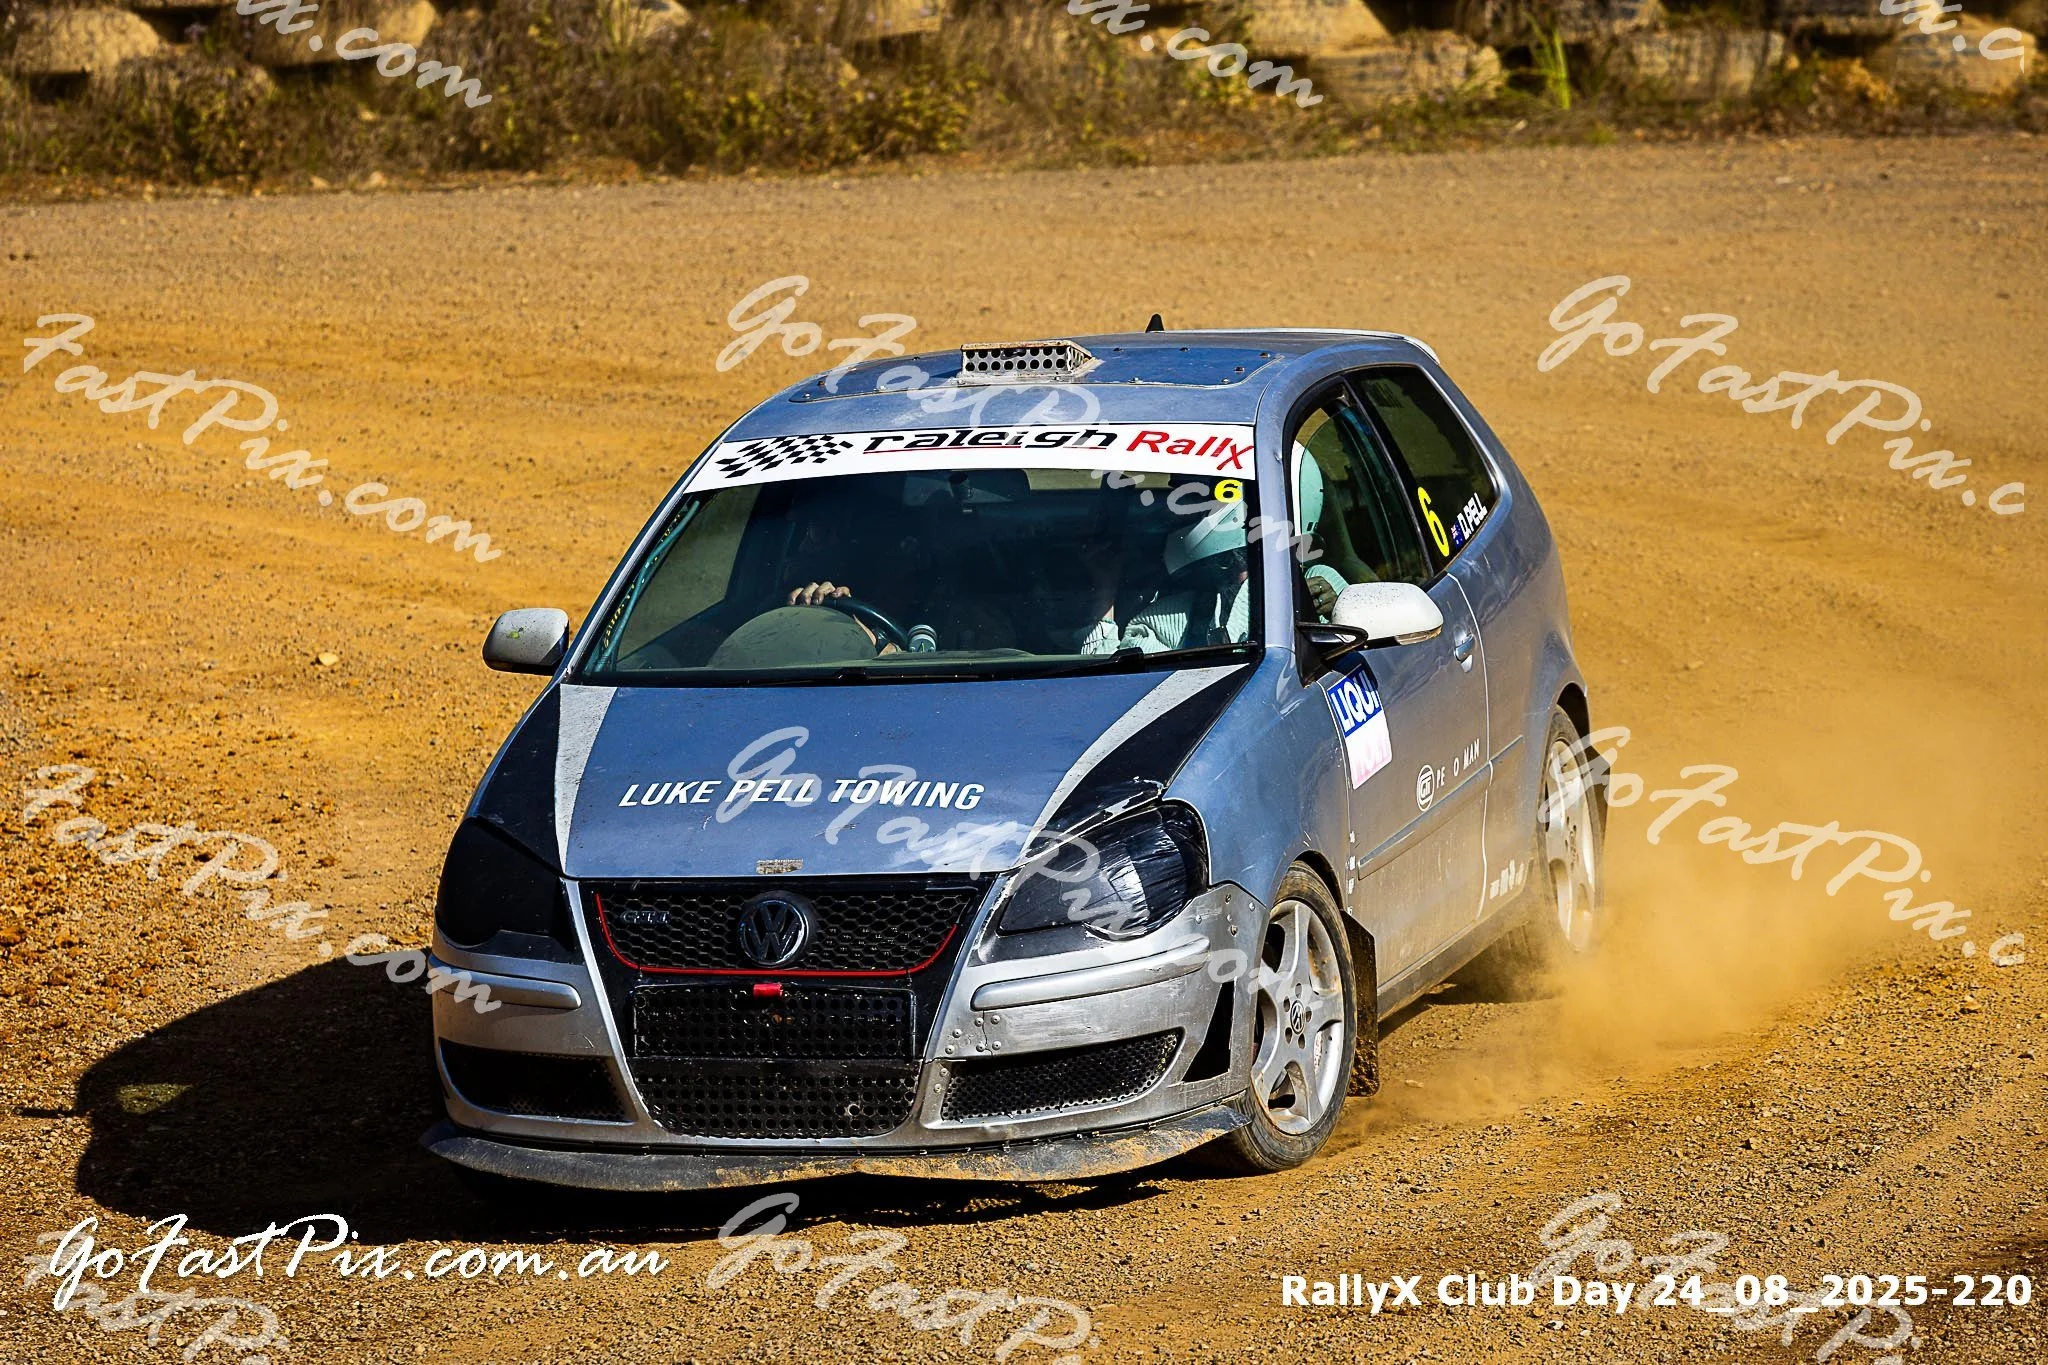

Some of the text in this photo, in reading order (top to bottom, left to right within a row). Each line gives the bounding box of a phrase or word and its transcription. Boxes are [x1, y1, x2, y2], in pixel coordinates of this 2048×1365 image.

[864, 429, 1118, 453] raleigh
[1214, 479, 1243, 503] 6
[1417, 486, 1450, 557] 6
[1456, 492, 1488, 540] D.PELL
[618, 778, 985, 810] LUKE PELL TOWING
